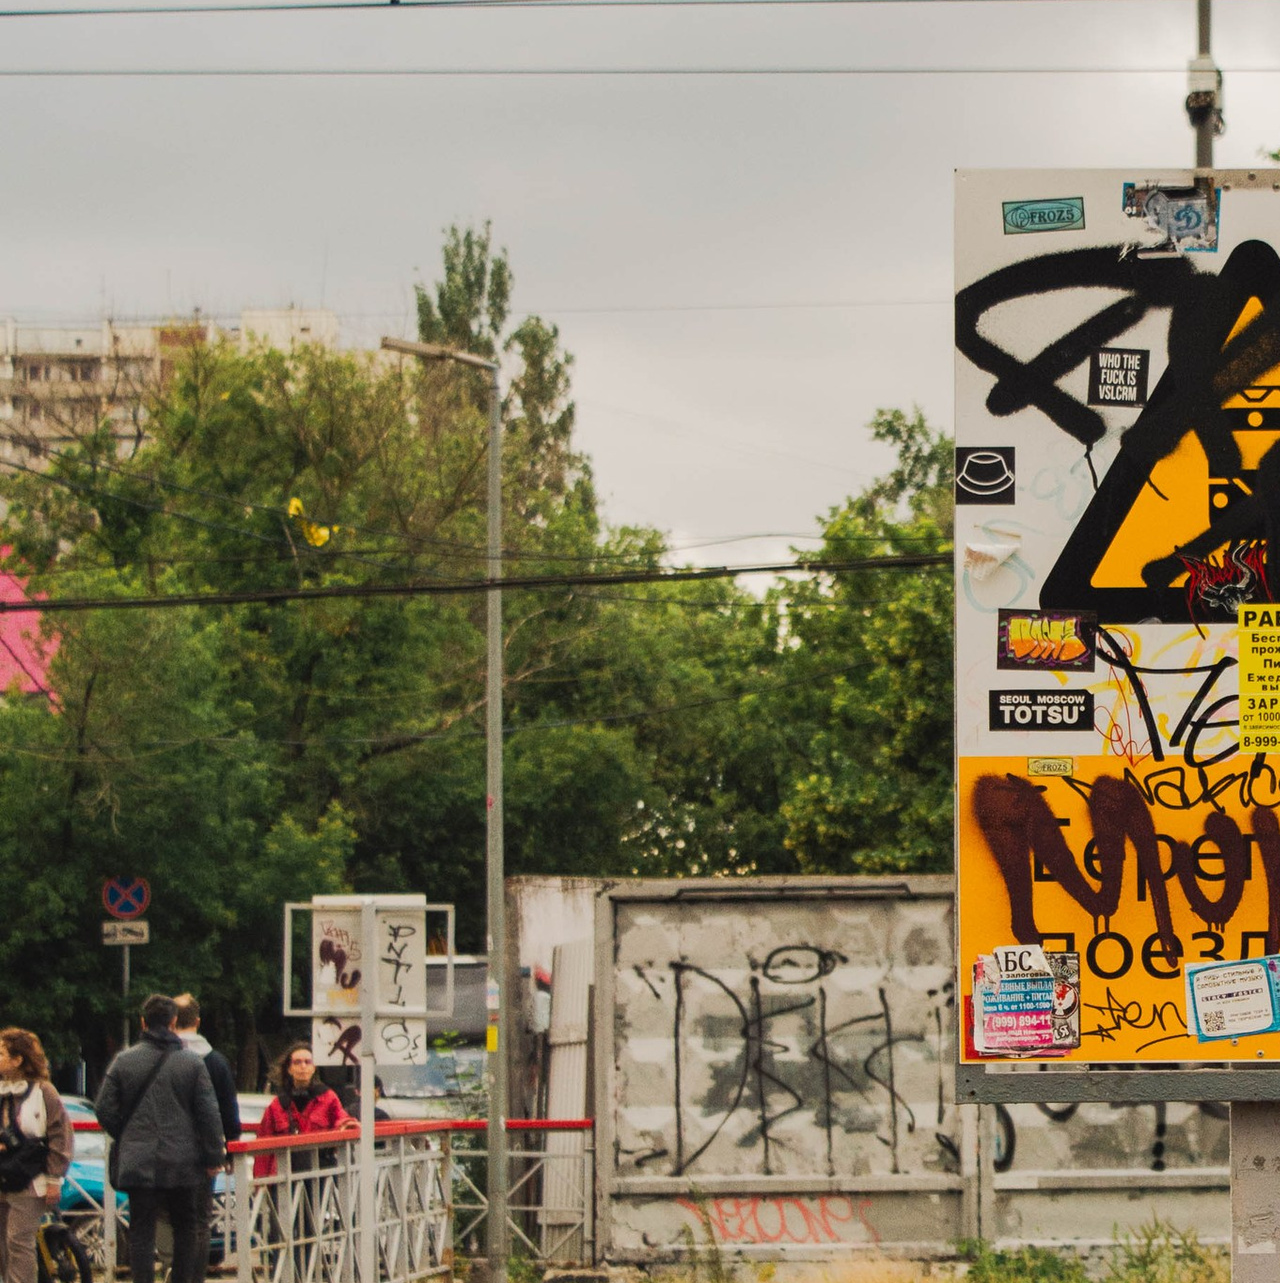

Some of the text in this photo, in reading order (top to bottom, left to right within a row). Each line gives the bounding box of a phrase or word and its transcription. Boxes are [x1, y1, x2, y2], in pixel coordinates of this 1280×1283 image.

[1099, 353, 1141, 370] WHO THE
[1101, 369, 1137, 385] FUCK IS
[1099, 385, 1137, 401] VSLCRM
[1000, 695, 1085, 704] SEOUL MOSCOW
[1243, 714, 1254, 722] от
